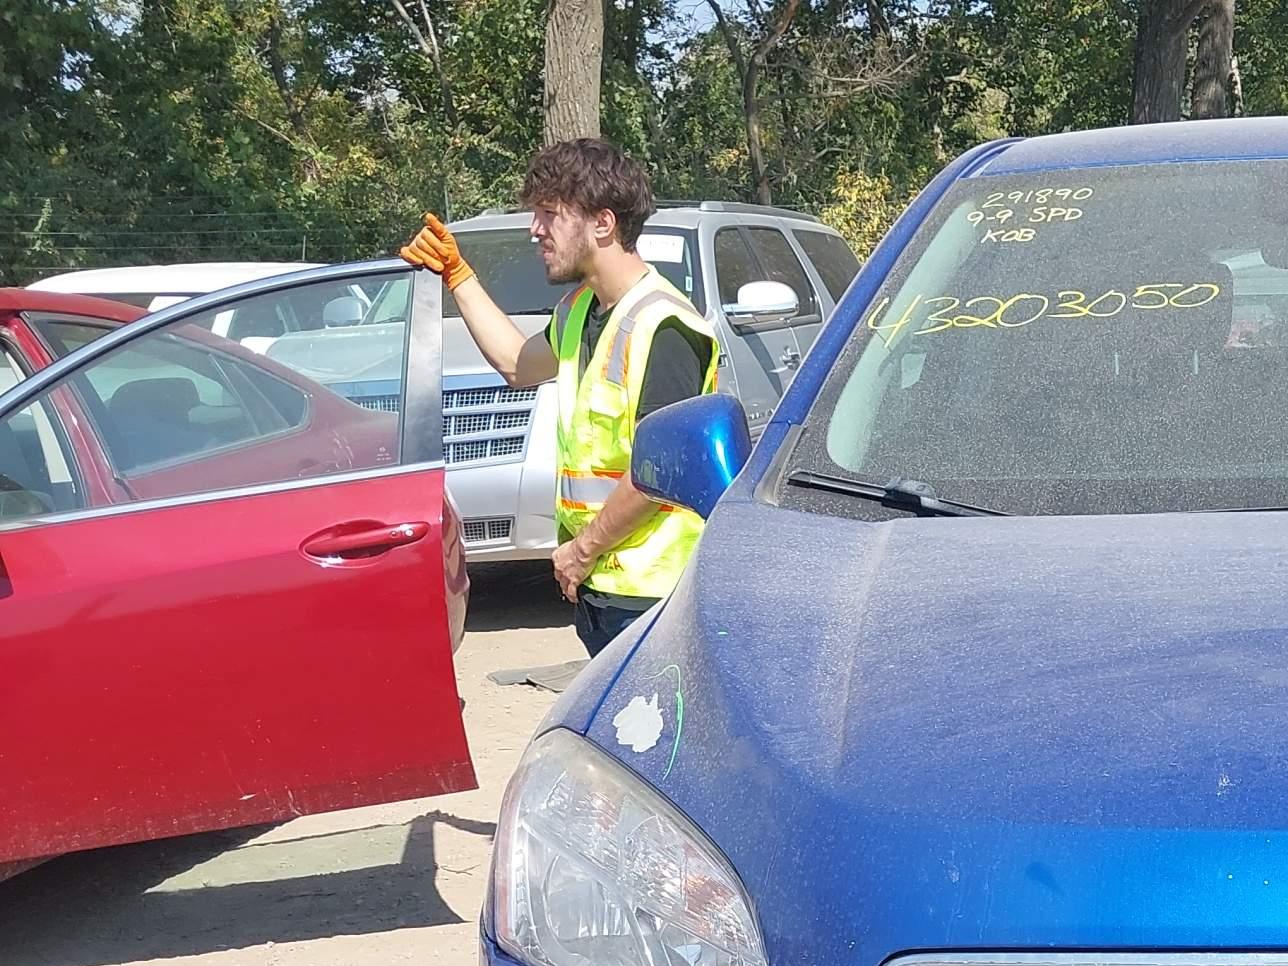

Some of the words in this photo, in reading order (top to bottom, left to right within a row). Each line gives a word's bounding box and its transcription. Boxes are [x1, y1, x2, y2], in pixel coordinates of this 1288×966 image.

[982, 187, 1093, 209] 291890
[966, 208, 1014, 228] 9-9
[1028, 206, 1084, 223] SPD
[867, 283, 1220, 348] 43203050
